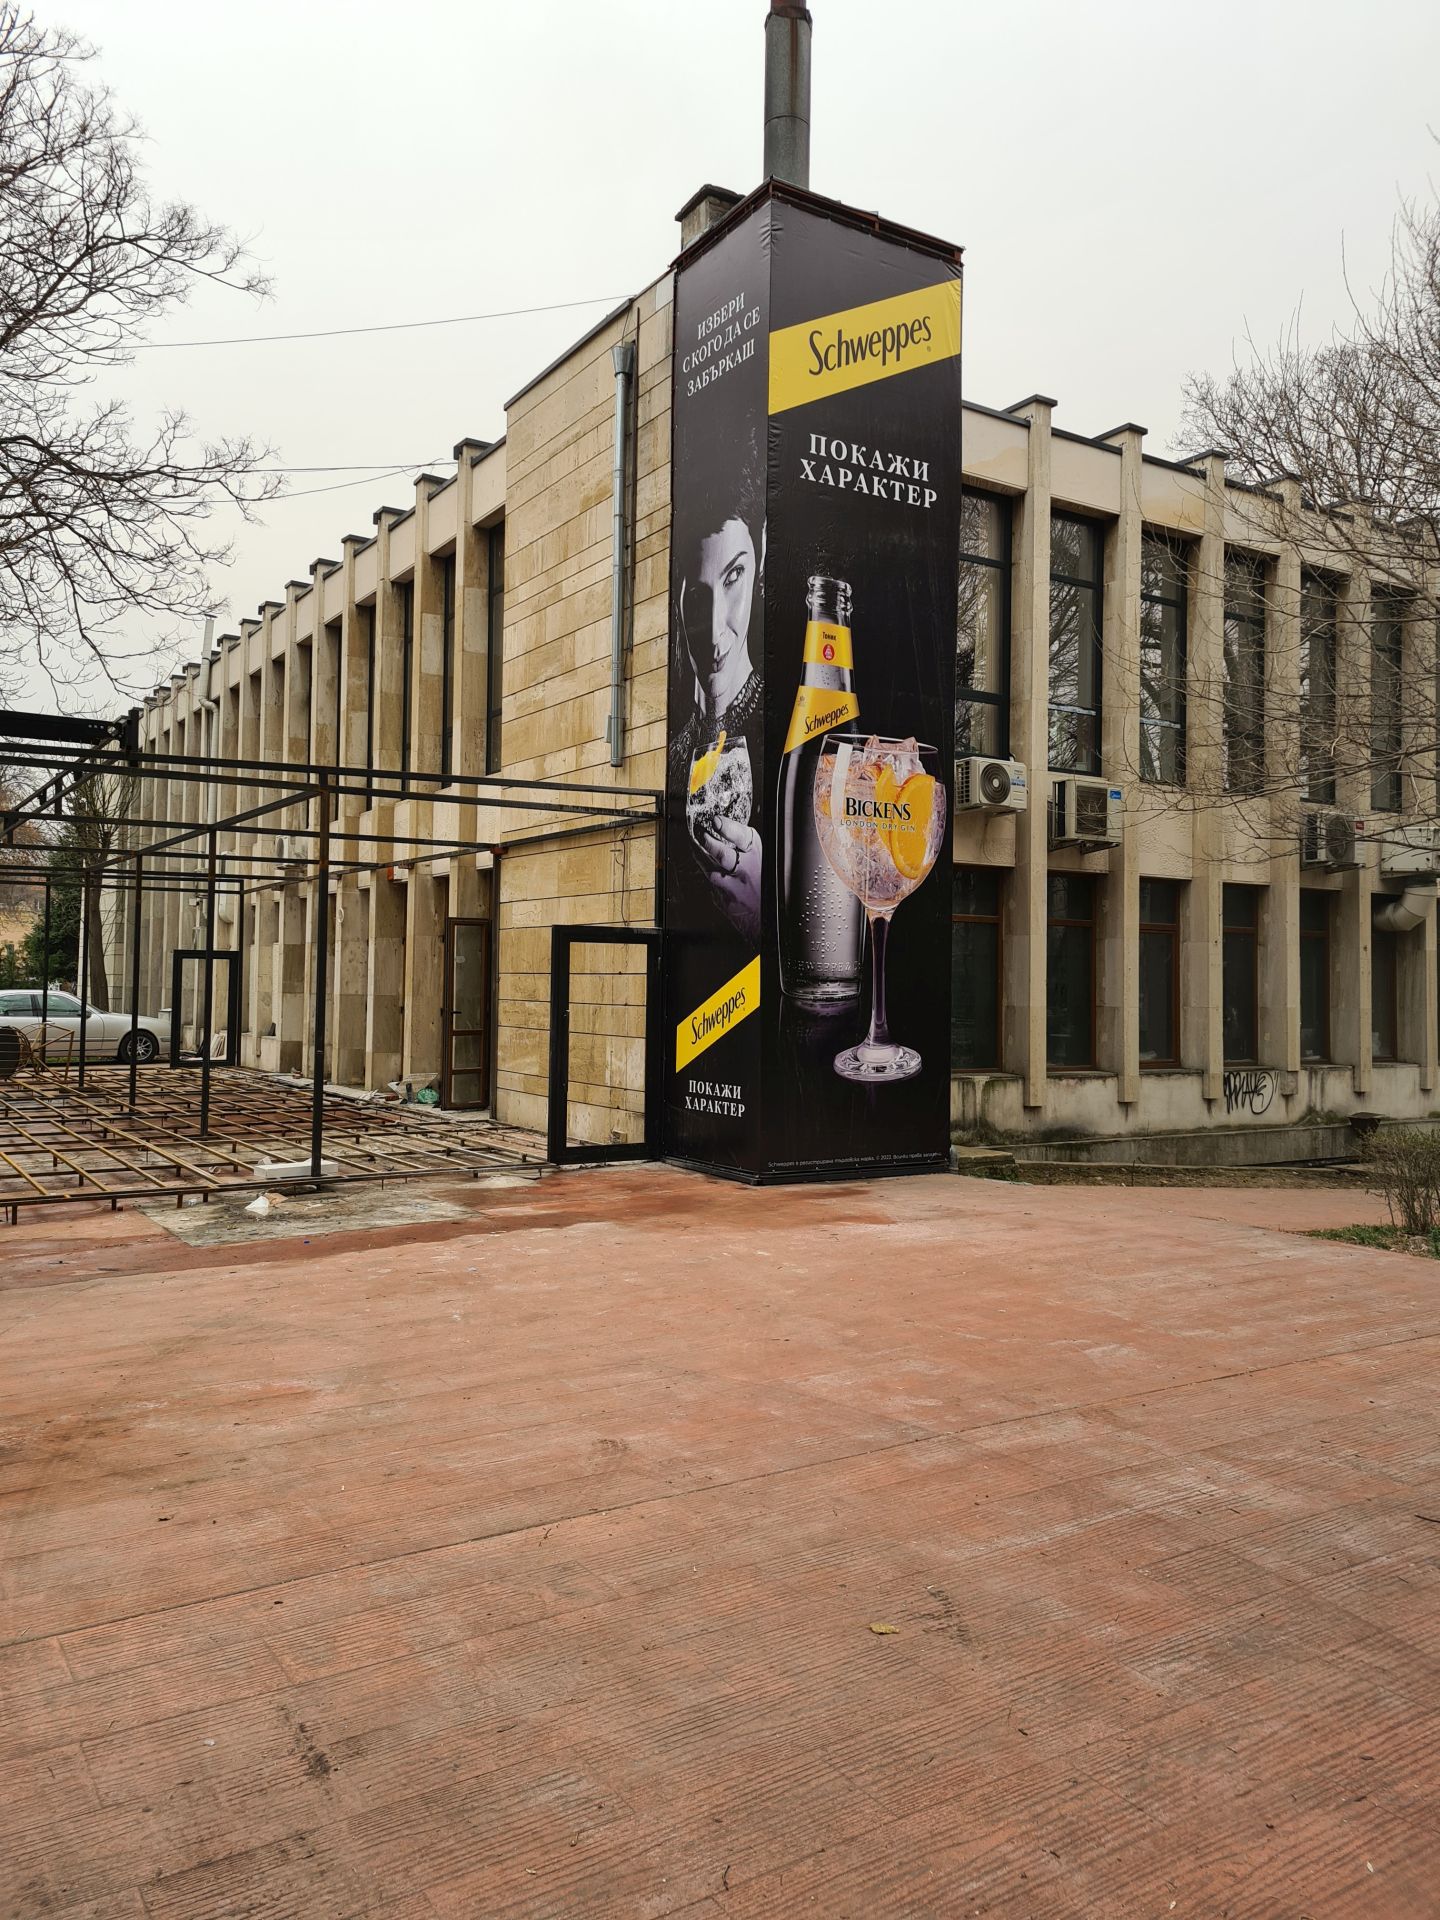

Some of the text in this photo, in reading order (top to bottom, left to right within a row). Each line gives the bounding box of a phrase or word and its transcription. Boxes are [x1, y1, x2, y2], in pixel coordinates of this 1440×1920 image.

[691, 335, 723, 369] КОГО
[724, 321, 742, 349] ДА
[743, 306, 761, 331] СЕ
[697, 292, 745, 340] ИЗБЕРИ
[687, 338, 755, 397] ЗАБЪРКАШ
[808, 315, 932, 376] Schweppes
[809, 433, 930, 482] ПОКАЖИ
[800, 458, 938, 509] ХАРАКТЕР
[804, 703, 849, 735] Schweppes
[840, 819, 878, 828] LONDON
[900, 824, 915, 832] GIN
[845, 797, 911, 821] BICKENS
[691, 987, 746, 1045] Schweppes
[685, 1095, 746, 1118] ХАРАКТЕР
[688, 1079, 742, 1100] ПОКАЖИ
